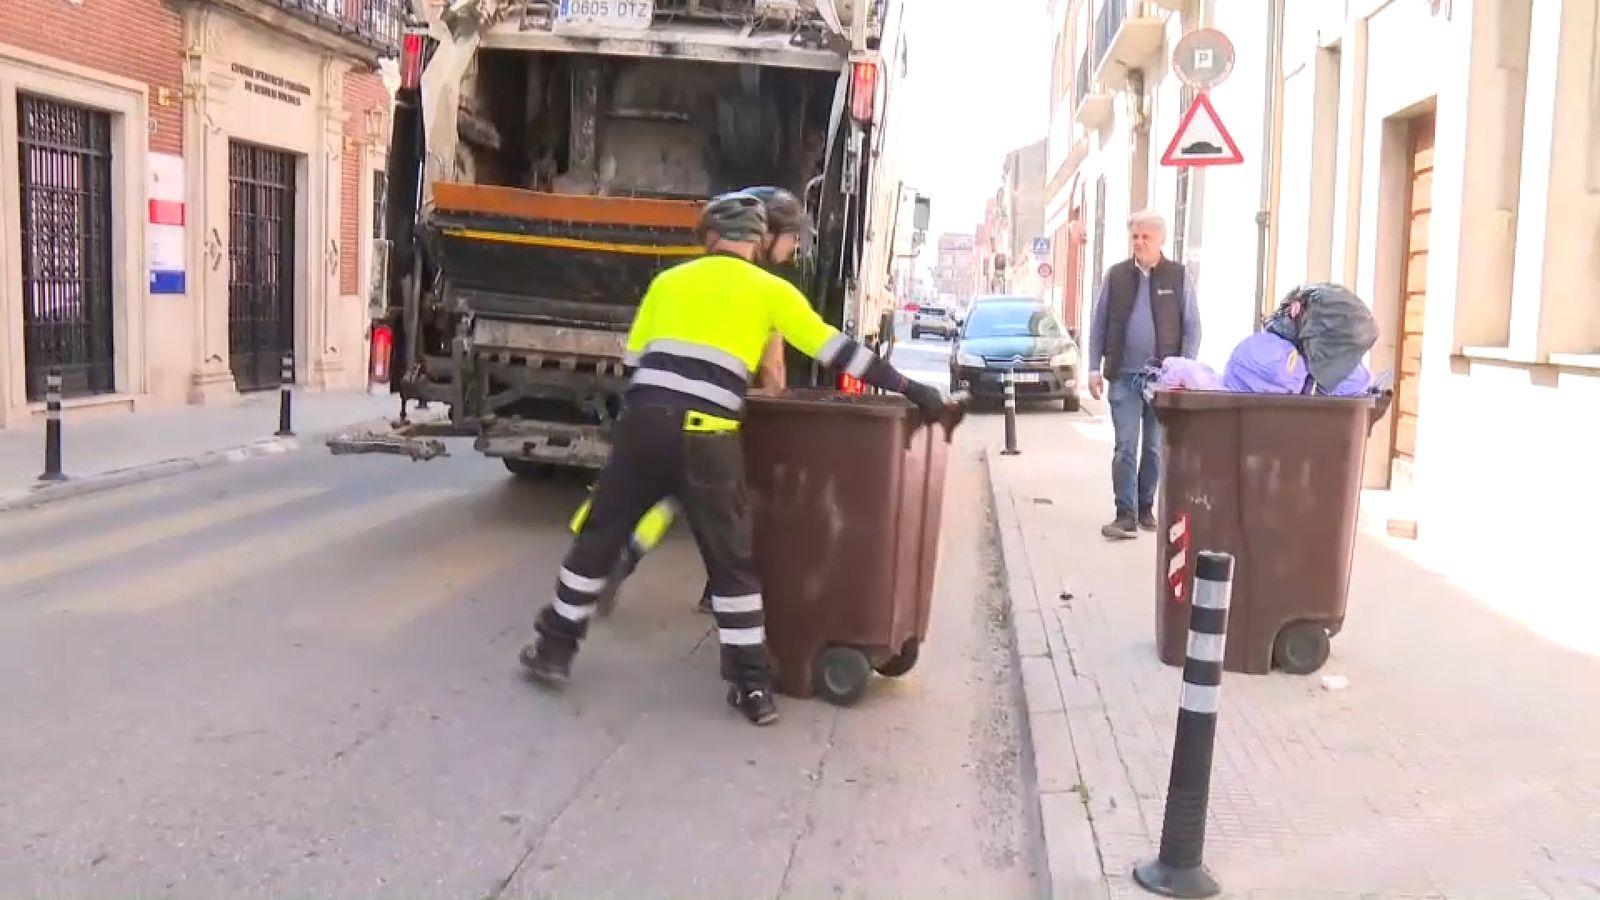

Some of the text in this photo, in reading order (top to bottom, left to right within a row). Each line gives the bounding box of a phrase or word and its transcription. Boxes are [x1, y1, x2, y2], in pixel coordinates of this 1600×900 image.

[571, 1, 648, 17] 0605 DTZ
[1199, 52, 1209, 65] P
